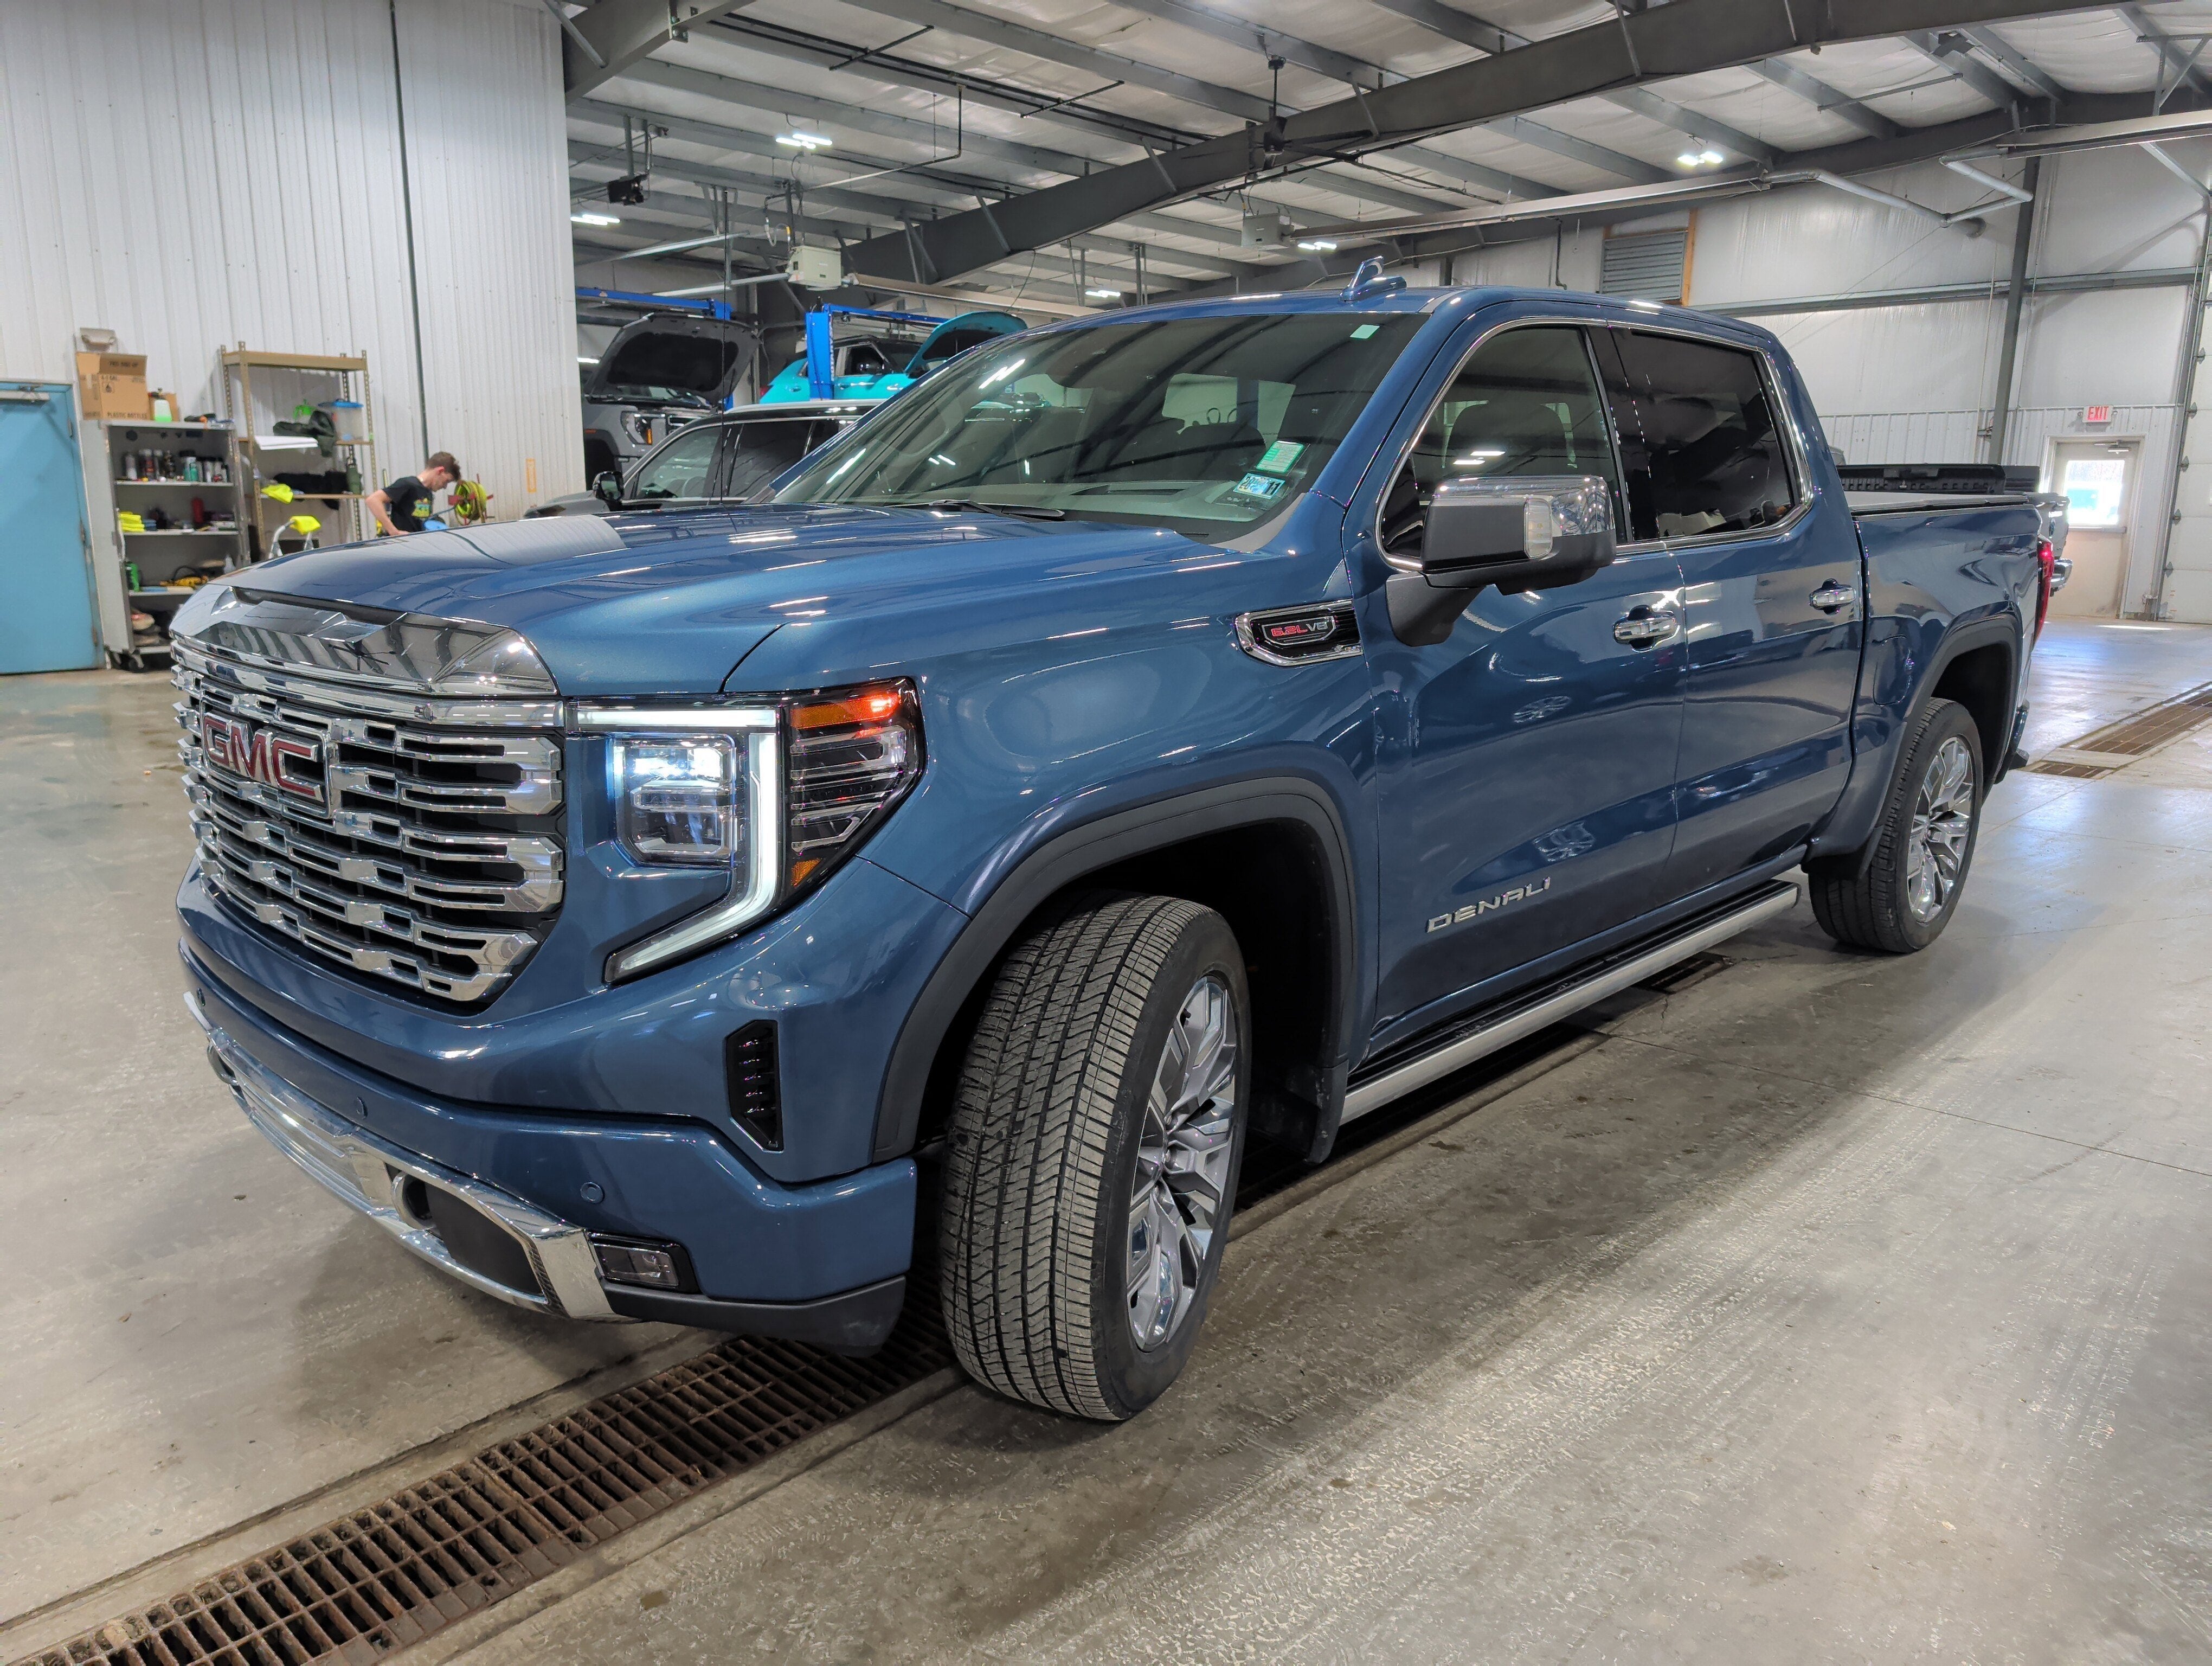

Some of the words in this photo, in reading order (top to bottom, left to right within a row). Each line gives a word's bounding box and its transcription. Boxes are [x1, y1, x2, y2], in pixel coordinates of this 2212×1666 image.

[2087, 406, 2109, 420] EXIT
[203, 712, 324, 803] GMC
[1426, 876, 1551, 933] DENALI
